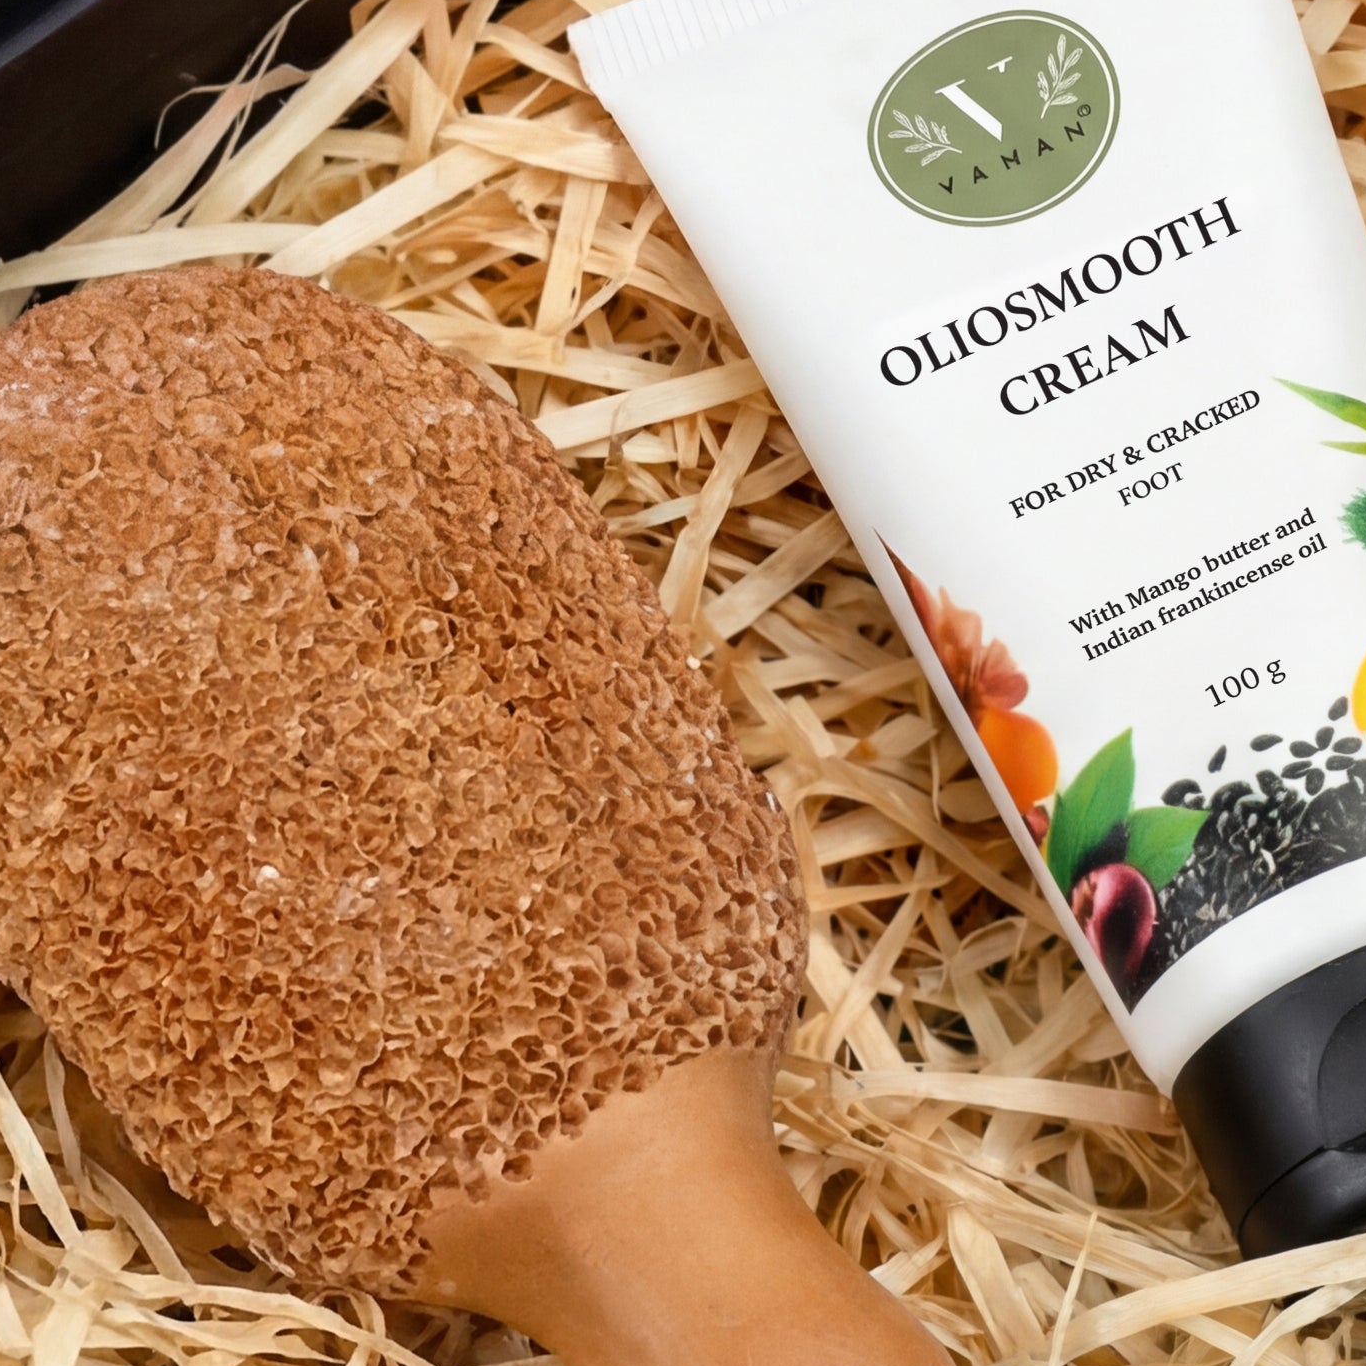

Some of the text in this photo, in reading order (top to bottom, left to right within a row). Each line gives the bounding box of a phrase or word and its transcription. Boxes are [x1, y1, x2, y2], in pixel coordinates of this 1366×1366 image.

[879, 196, 1242, 387] OLIOSMOOTH
[999, 304, 1191, 416] CREAM
[1008, 389, 1261, 519] FOR DRY & CRACKED
[1117, 462, 1185, 507] FOOT
[1068, 506, 1317, 635] With Mango butter and
[1081, 532, 1329, 662] Indian frankincense oil
[1204, 658, 1287, 708] 100 g
